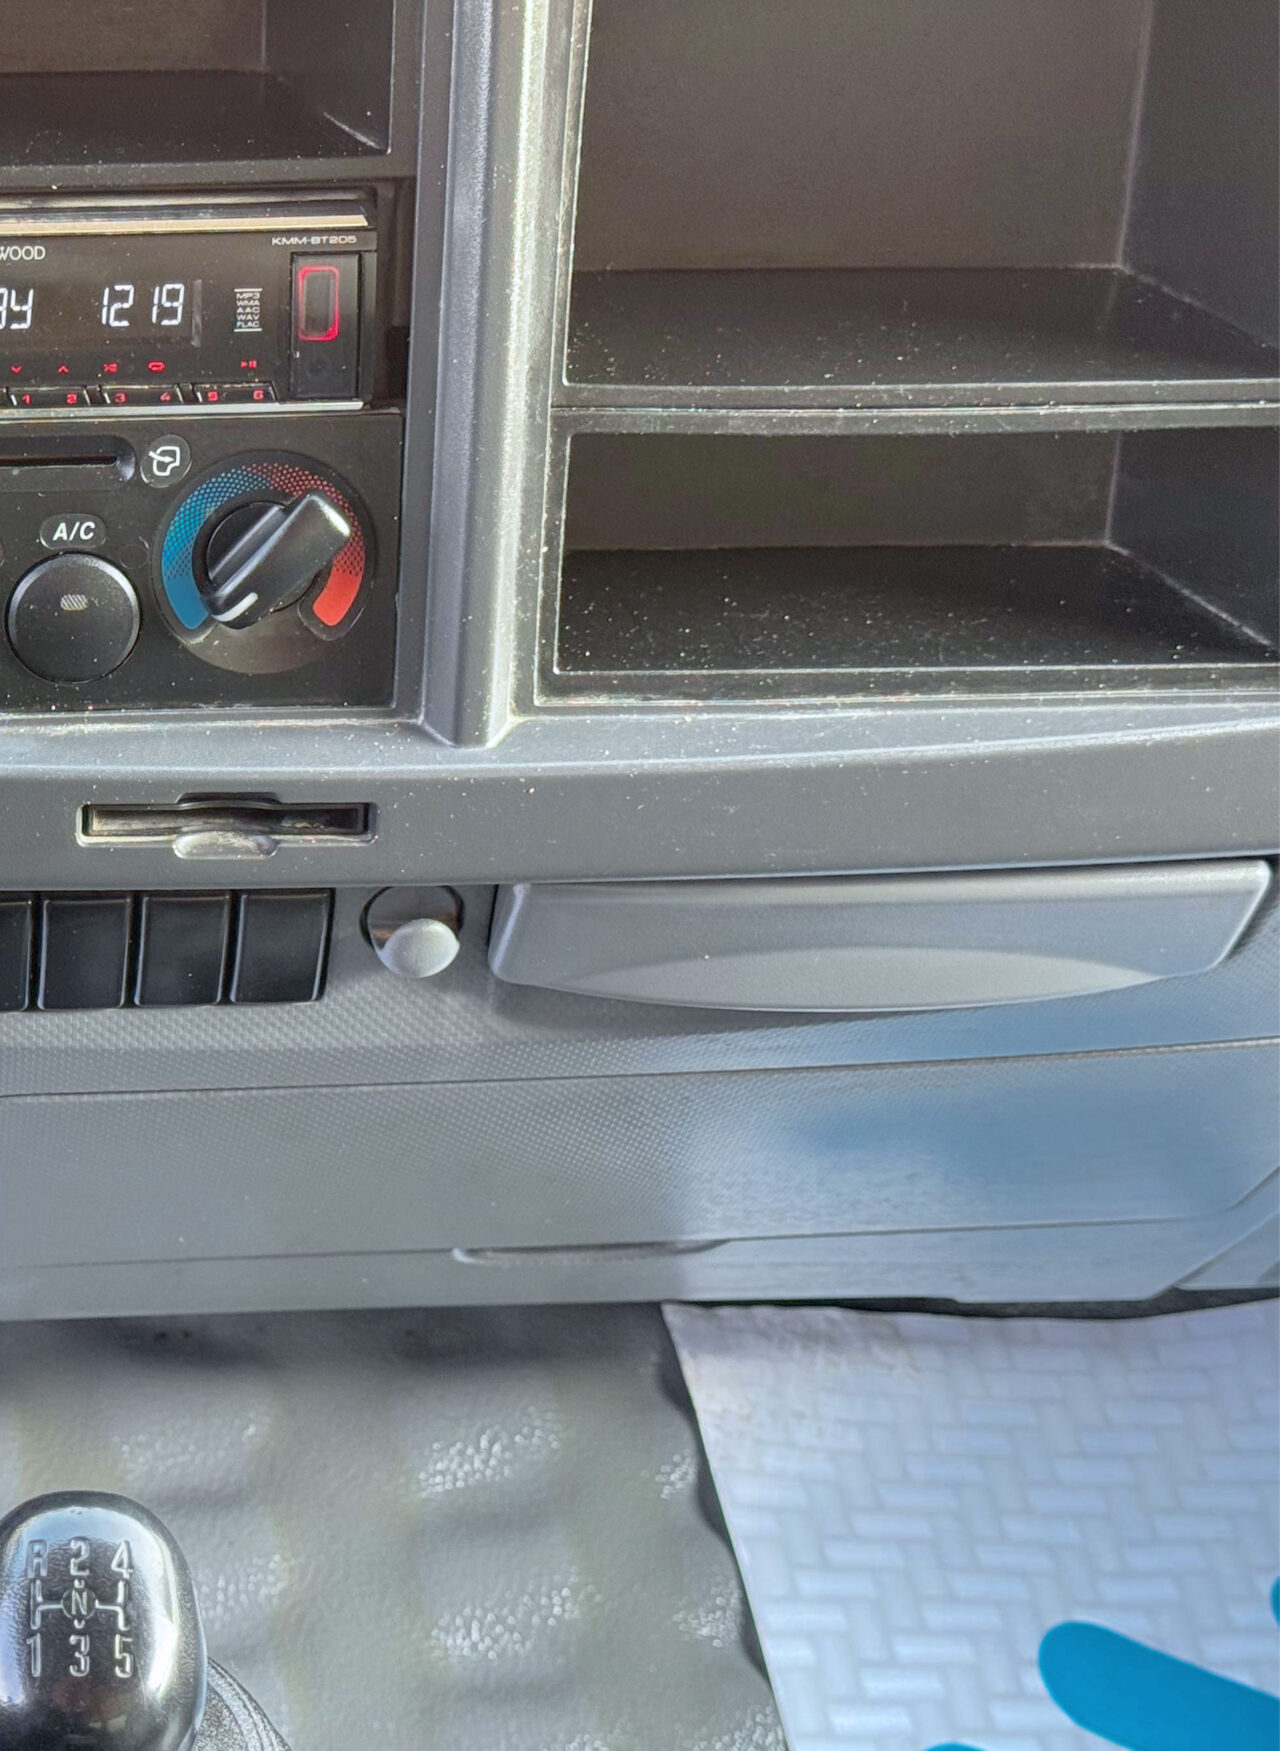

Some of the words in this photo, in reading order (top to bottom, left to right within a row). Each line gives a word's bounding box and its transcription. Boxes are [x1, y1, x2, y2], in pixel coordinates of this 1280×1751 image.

[271, 235, 357, 246] KMM-BT205
[22, 395, 31, 405] 1
[66, 394, 77, 405] 2
[115, 393, 126, 403] 3
[160, 391, 170, 401] 4
[207, 391, 219, 401] 5
[252, 389, 264, 400] 6
[52, 521, 96, 541] A/C
[26, 1538, 49, 1578] R
[70, 1536, 90, 1576] 2
[111, 1539, 133, 1579] 4
[71, 1587, 88, 1616] N
[26, 1632, 42, 1678] 1
[70, 1634, 90, 1677] 3
[115, 1633, 133, 1678] 5
